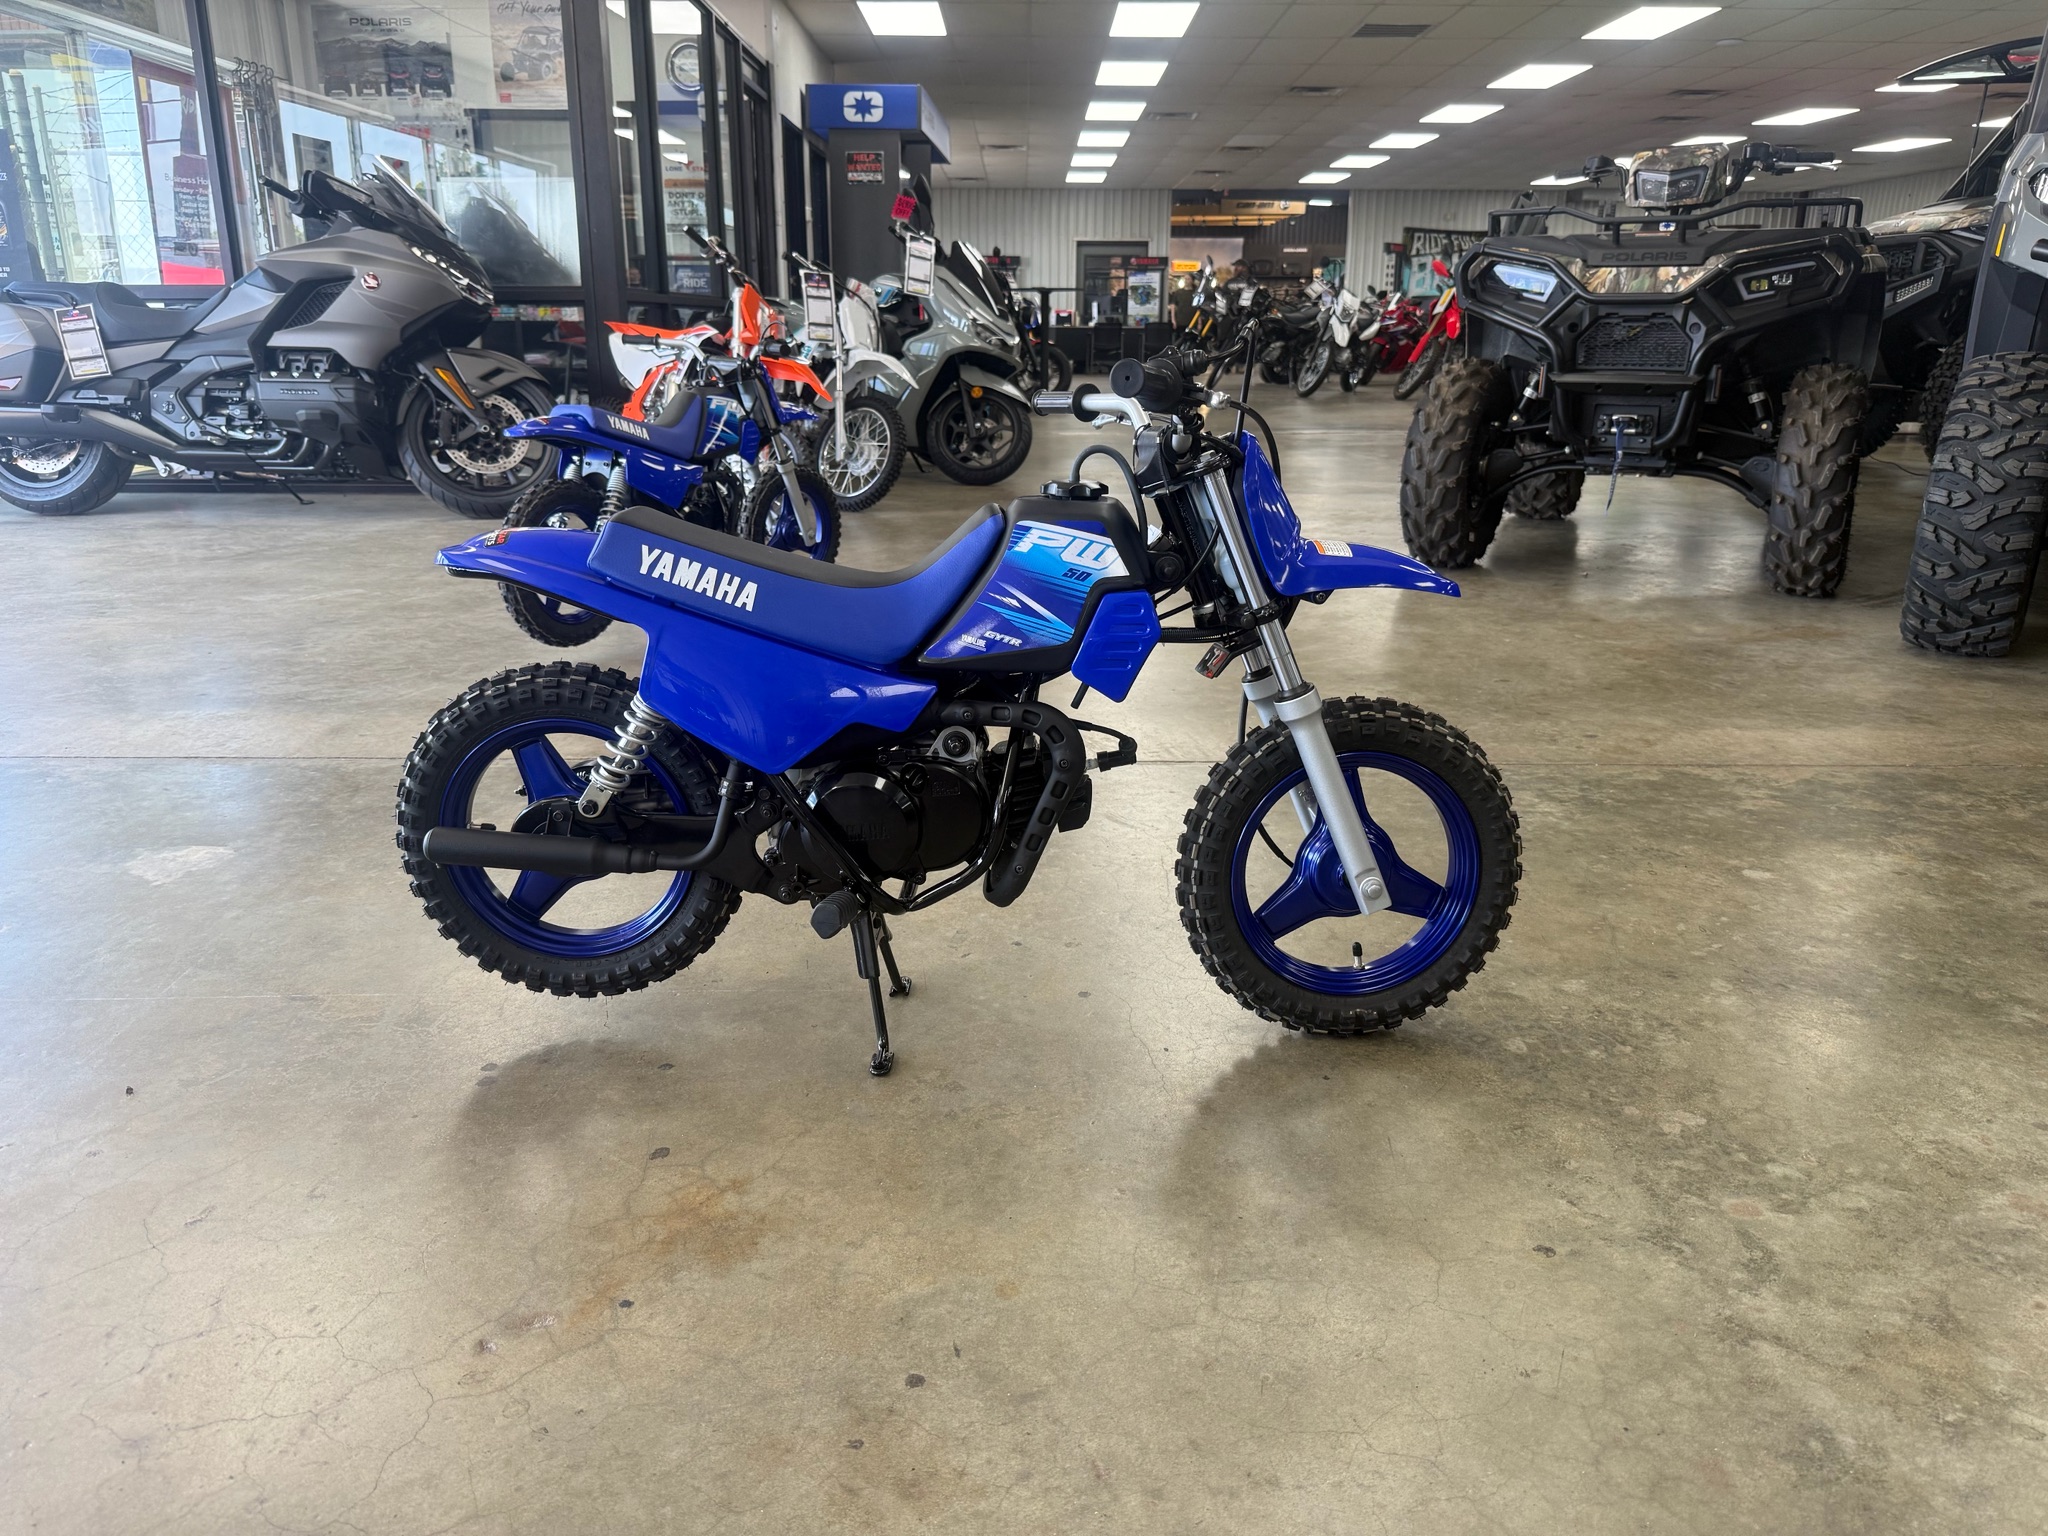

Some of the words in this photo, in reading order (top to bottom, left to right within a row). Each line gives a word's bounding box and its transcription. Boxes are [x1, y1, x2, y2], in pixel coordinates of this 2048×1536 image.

[350, 17, 412, 27] POLARIS
[847, 163, 882, 171] WANTED
[1410, 233, 1448, 255] RIDE
[1602, 252, 1687, 261] POLARIS
[683, 278, 708, 288] RIDE
[606, 415, 650, 440] YAMAHA
[1013, 527, 1120, 570] PW
[640, 545, 758, 611] YAMAHA
[1062, 568, 1092, 582] 50
[961, 634, 987, 648] YAMALUBE
[984, 630, 1022, 647] GYTR
